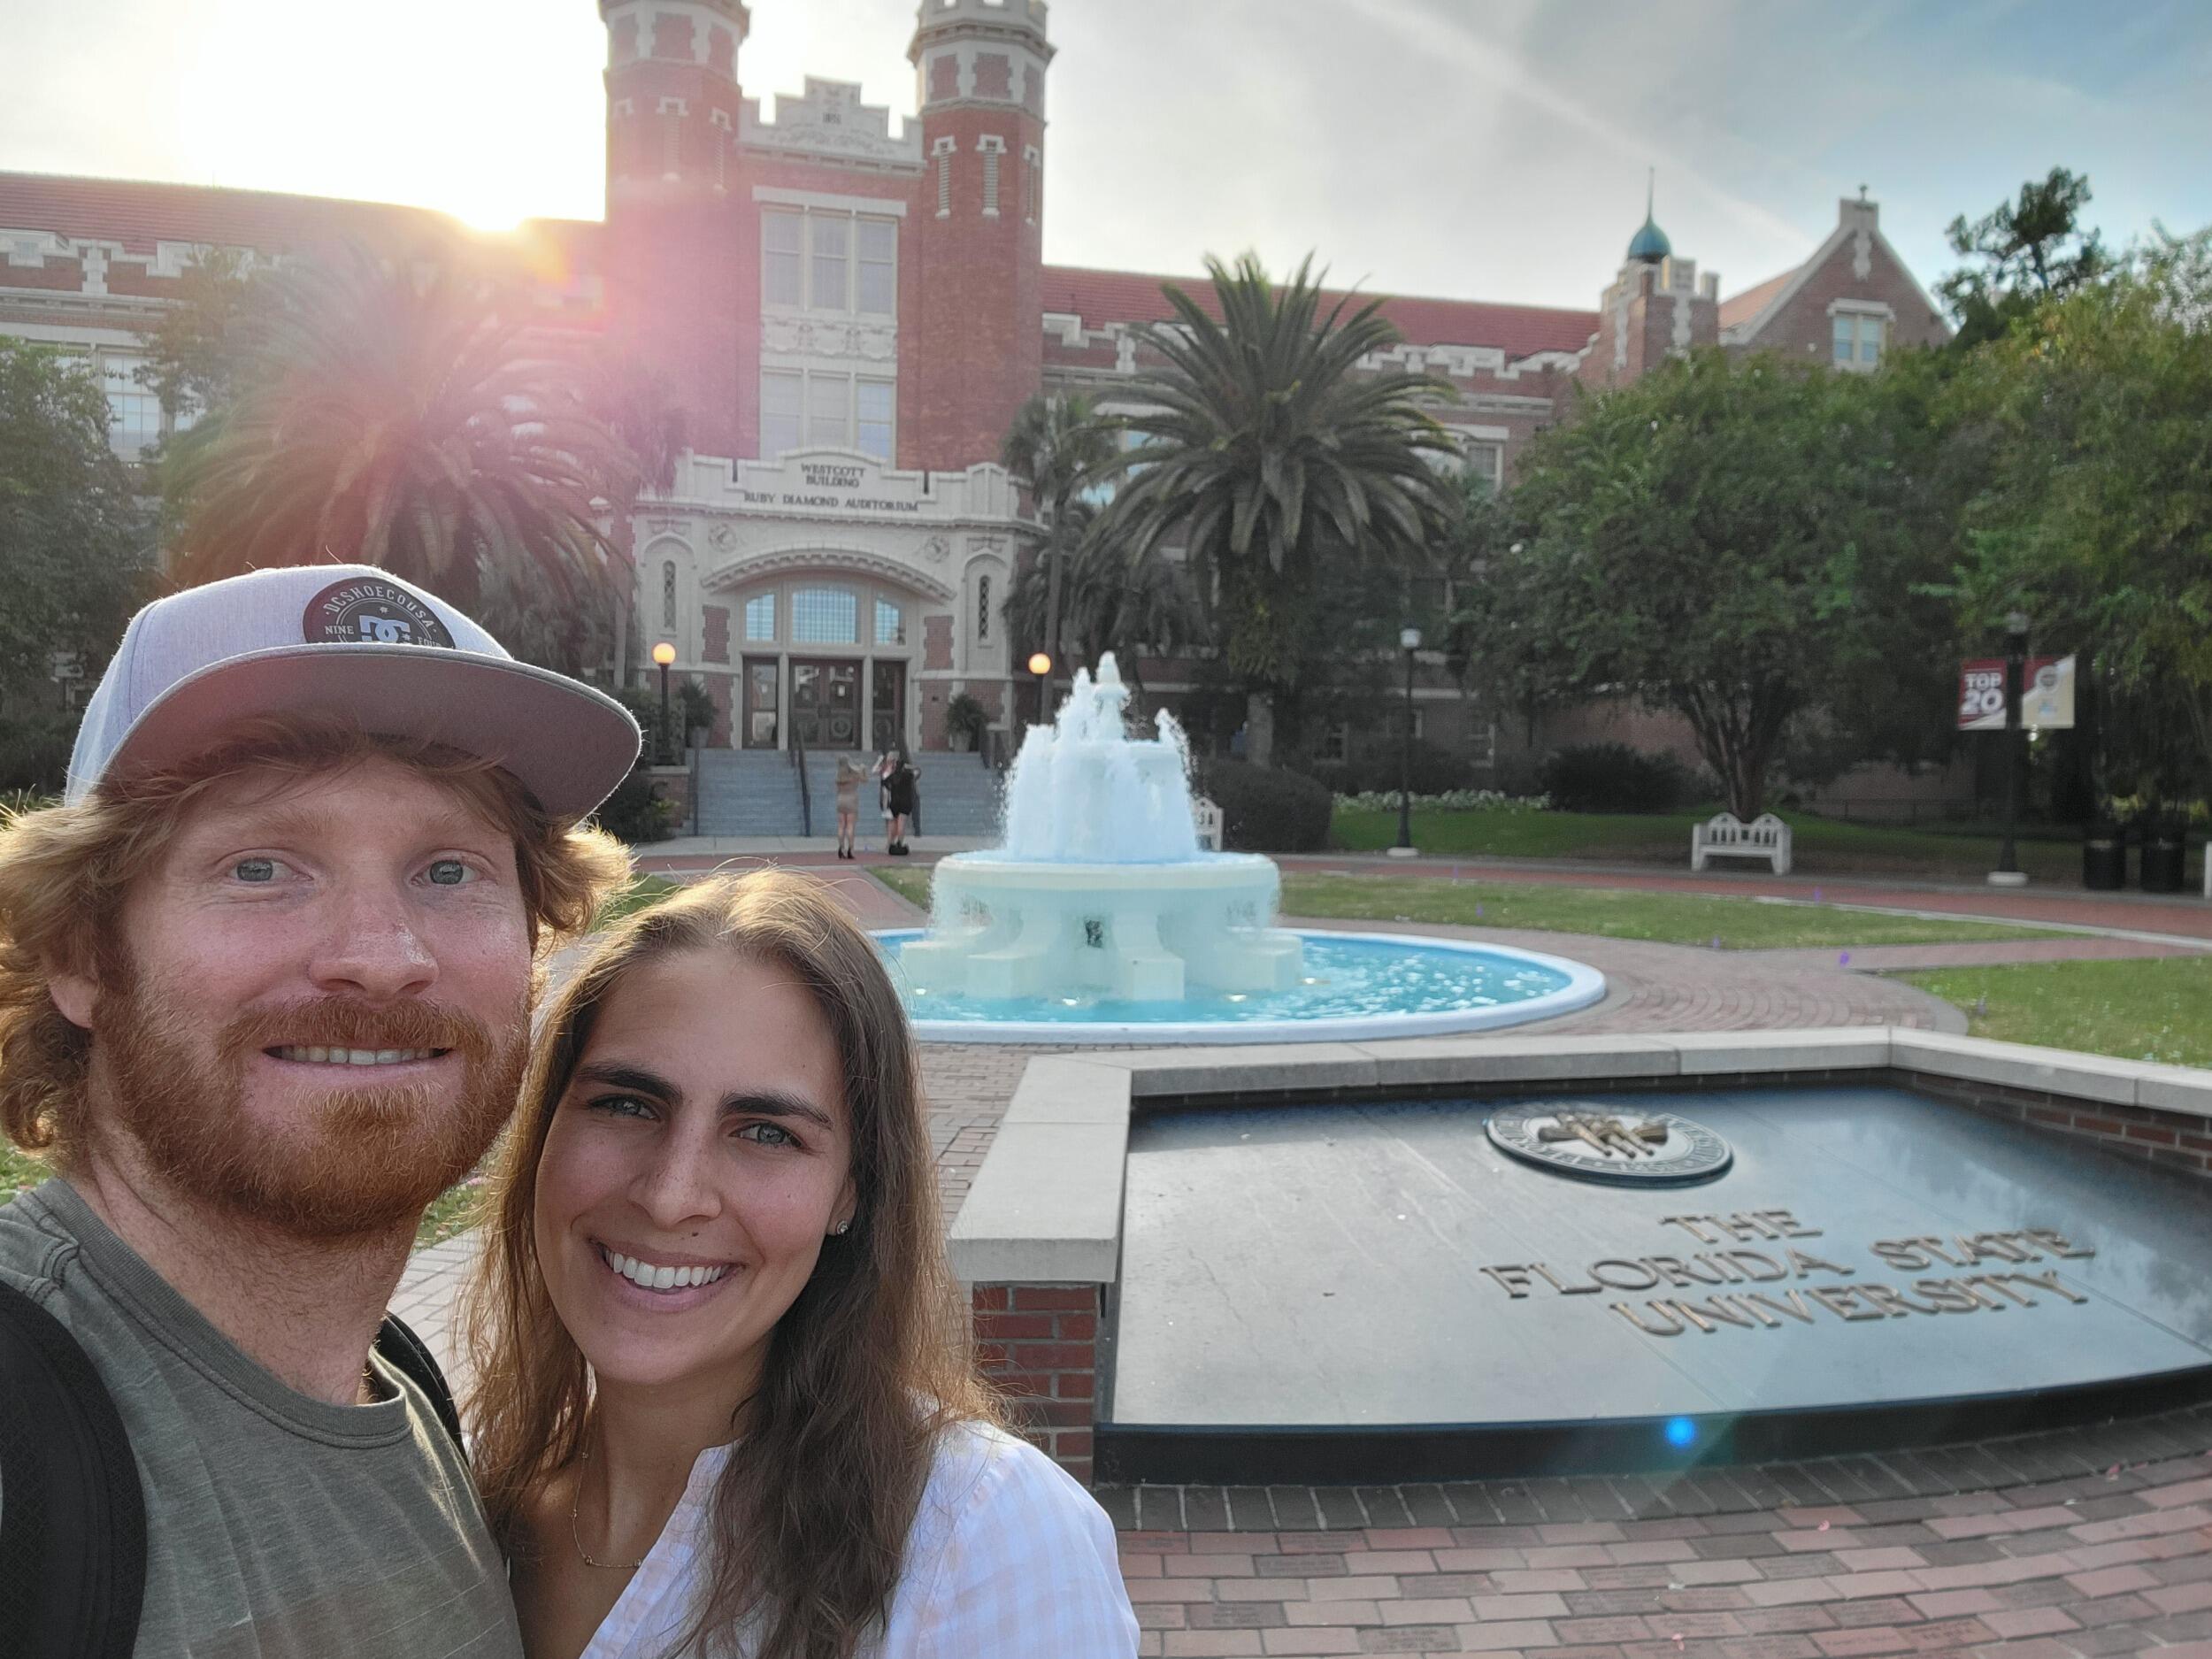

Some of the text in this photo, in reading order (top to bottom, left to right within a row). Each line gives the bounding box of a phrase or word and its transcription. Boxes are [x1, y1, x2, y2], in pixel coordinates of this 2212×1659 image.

[801, 463, 867, 478] WESTCOTT
[805, 475, 860, 488] BUILDING
[743, 492, 919, 512] RUBY DIAMOND AUDITORIUM
[325, 625, 354, 635] NINE
[1963, 672, 2003, 691] TOP
[1959, 687, 2005, 715] 20
[1660, 1209, 1824, 1244] THE
[1479, 1227, 2097, 1299] FLORIDA STATE
[1609, 1269, 2089, 1337] UNIVERSITY
